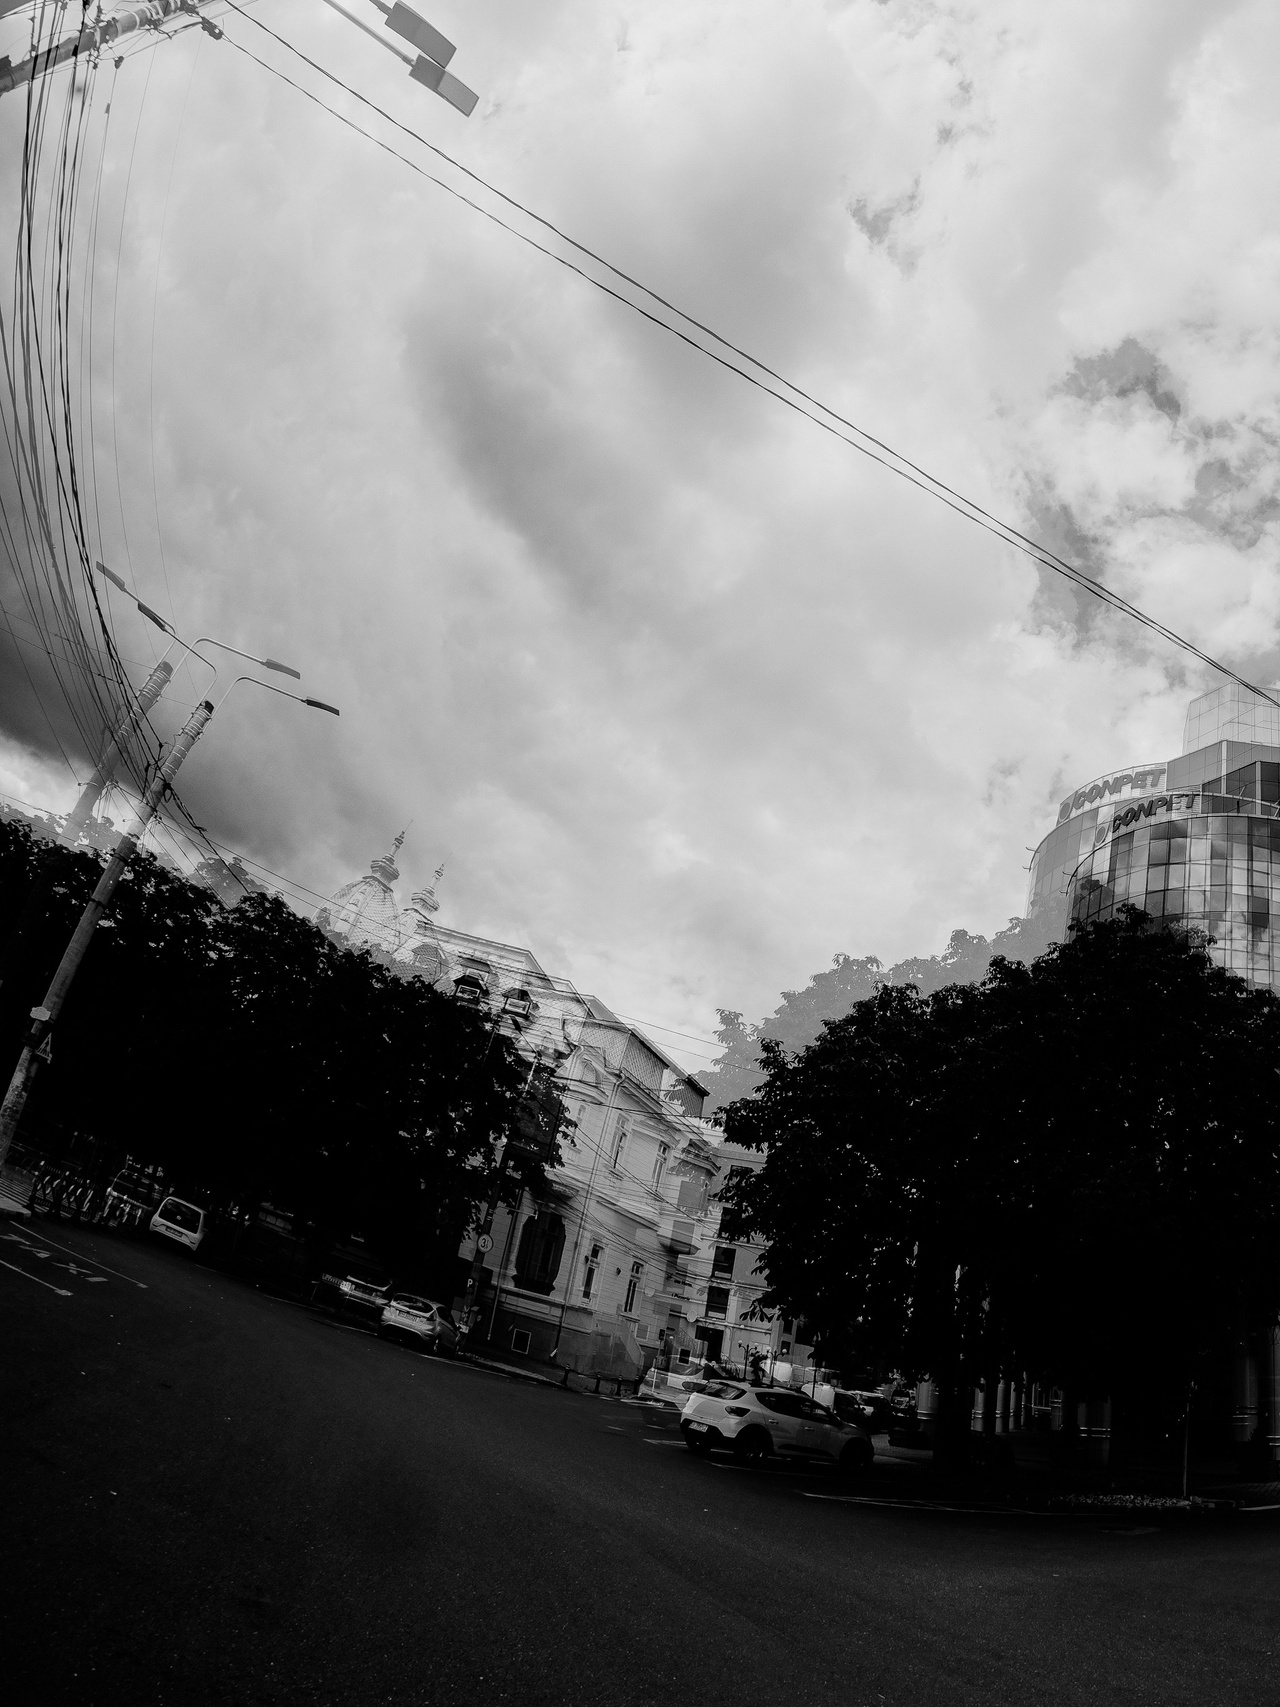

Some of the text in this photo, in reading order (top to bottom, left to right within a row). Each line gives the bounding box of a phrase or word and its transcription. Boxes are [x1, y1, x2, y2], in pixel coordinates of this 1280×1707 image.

[1073, 768, 1166, 809] CONPET
[1112, 794, 1200, 832] CONPET
[467, 1279, 474, 1287] P
